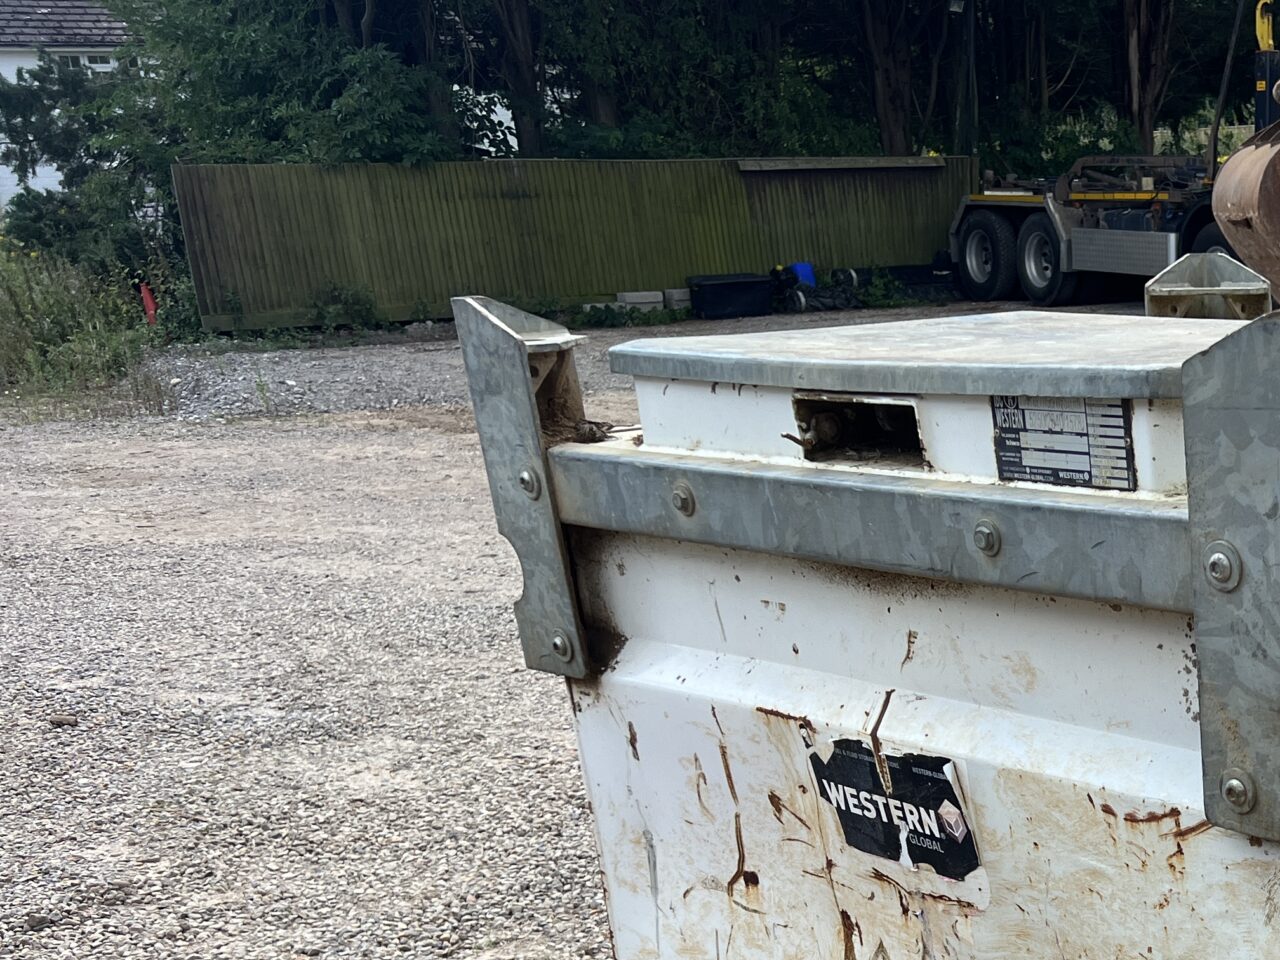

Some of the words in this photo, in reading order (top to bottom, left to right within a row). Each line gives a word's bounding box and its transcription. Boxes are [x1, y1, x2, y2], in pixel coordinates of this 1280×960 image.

[994, 408, 1024, 428] WESTERN
[822, 778, 941, 839] WESTERN
[908, 833, 945, 854] GLOBAL
